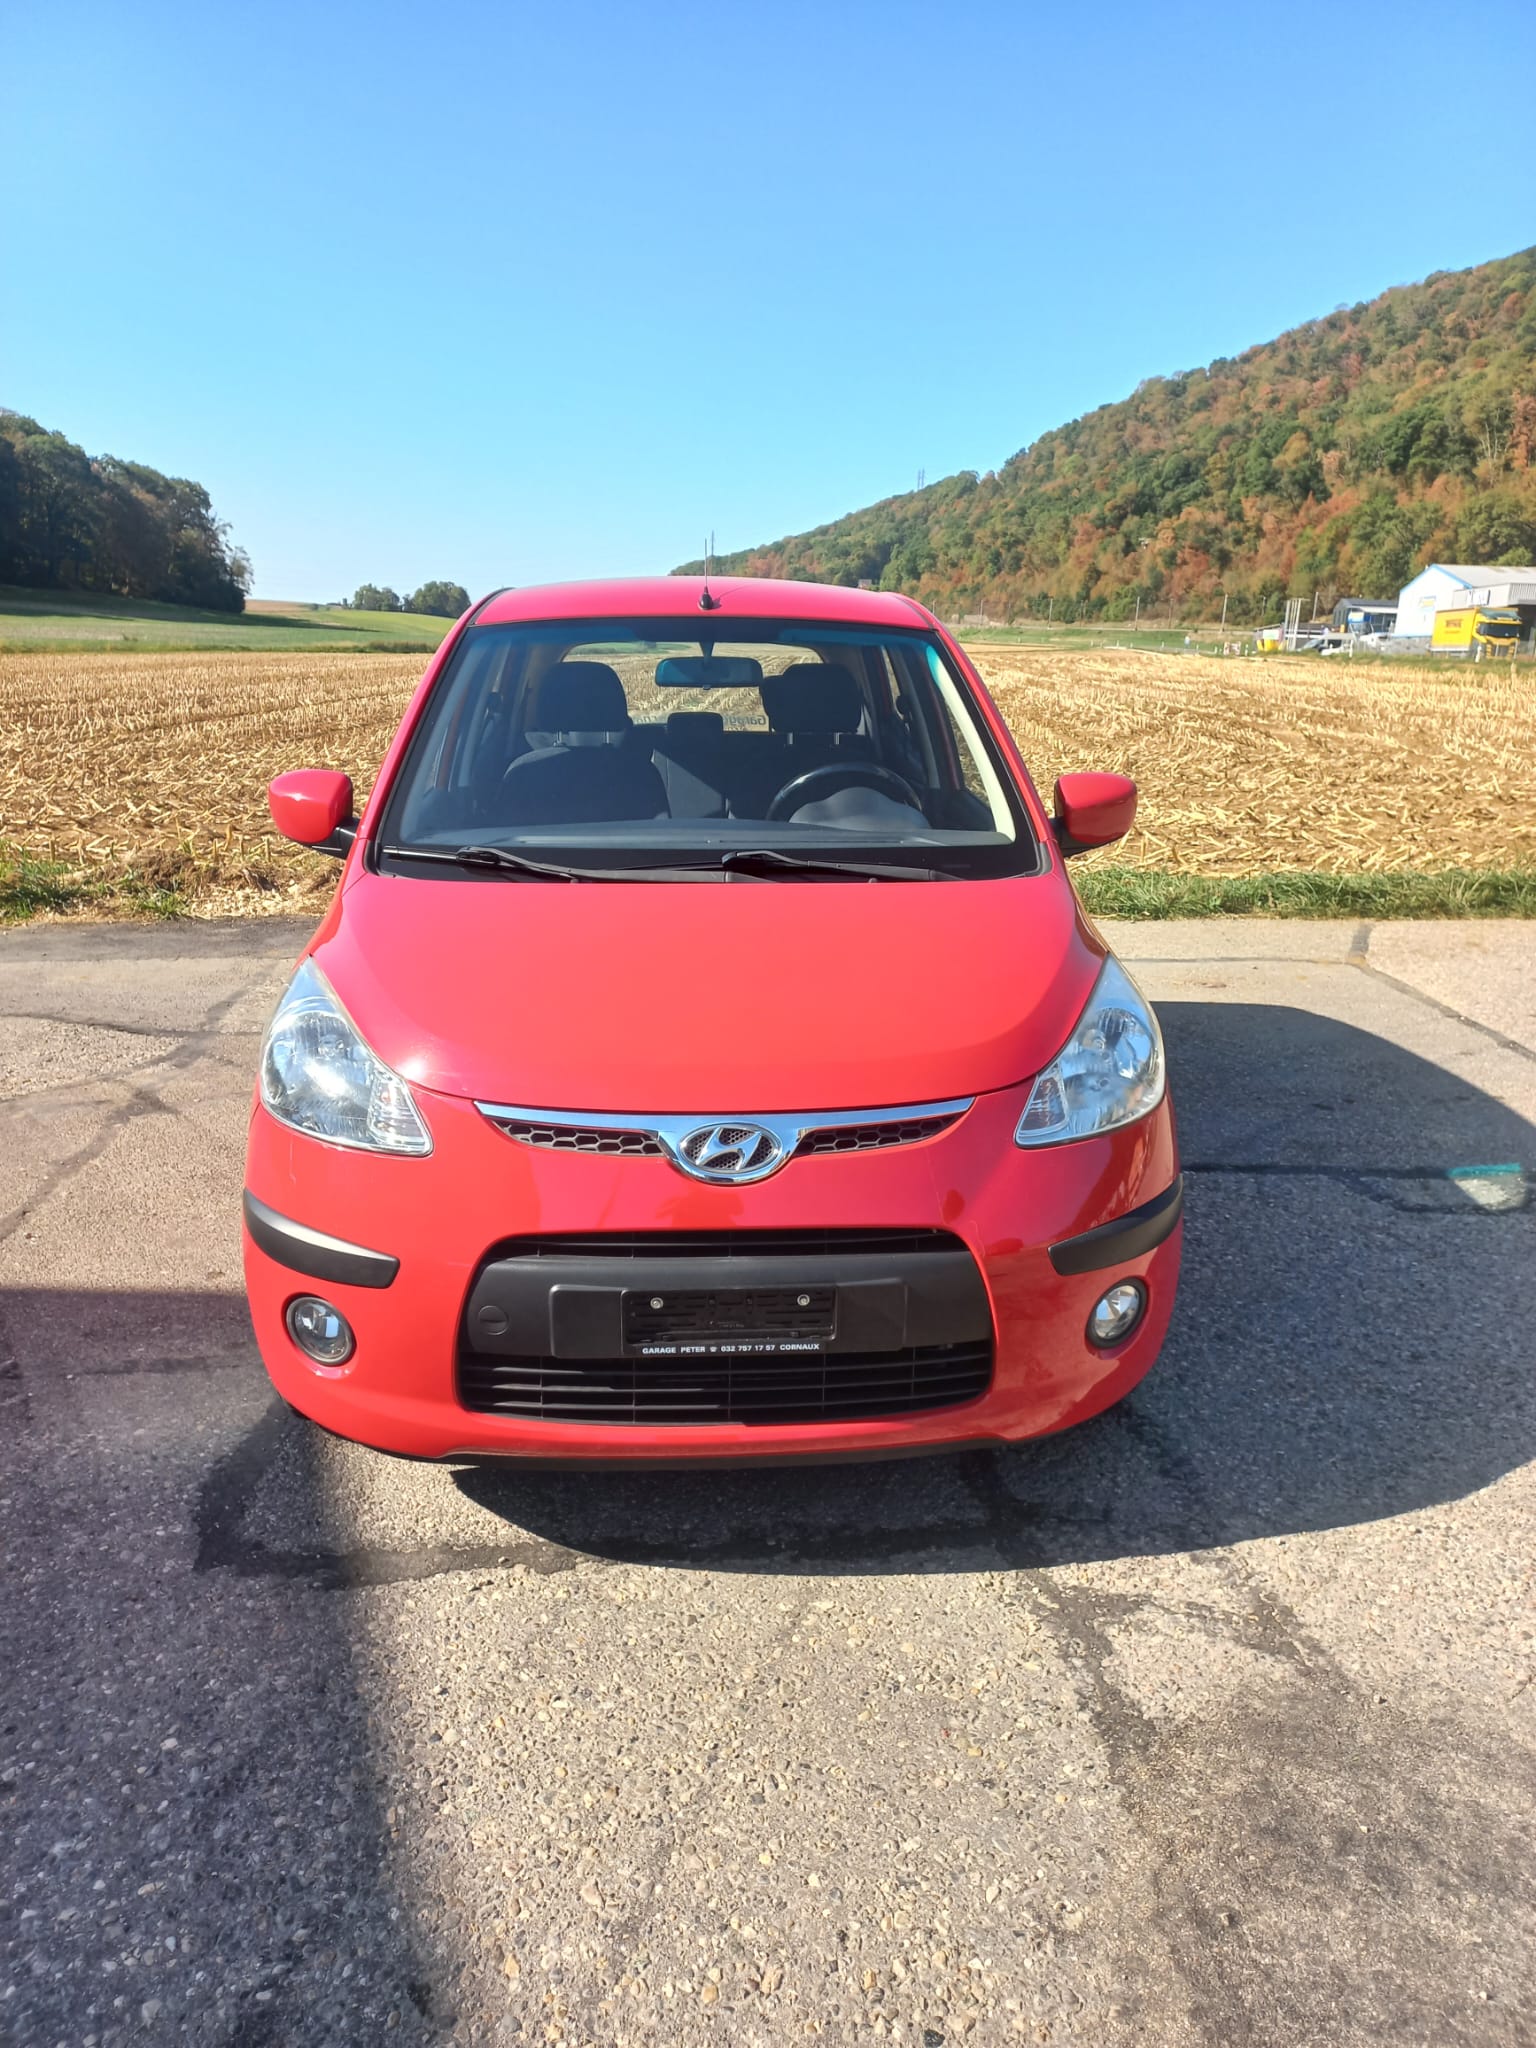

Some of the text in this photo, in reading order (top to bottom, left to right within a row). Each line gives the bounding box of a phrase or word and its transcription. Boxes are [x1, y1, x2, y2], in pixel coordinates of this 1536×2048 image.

[642, 1347, 677, 1355] GARAGE
[681, 1346, 706, 1354] PETER
[779, 1343, 820, 1351] CORNAUX
